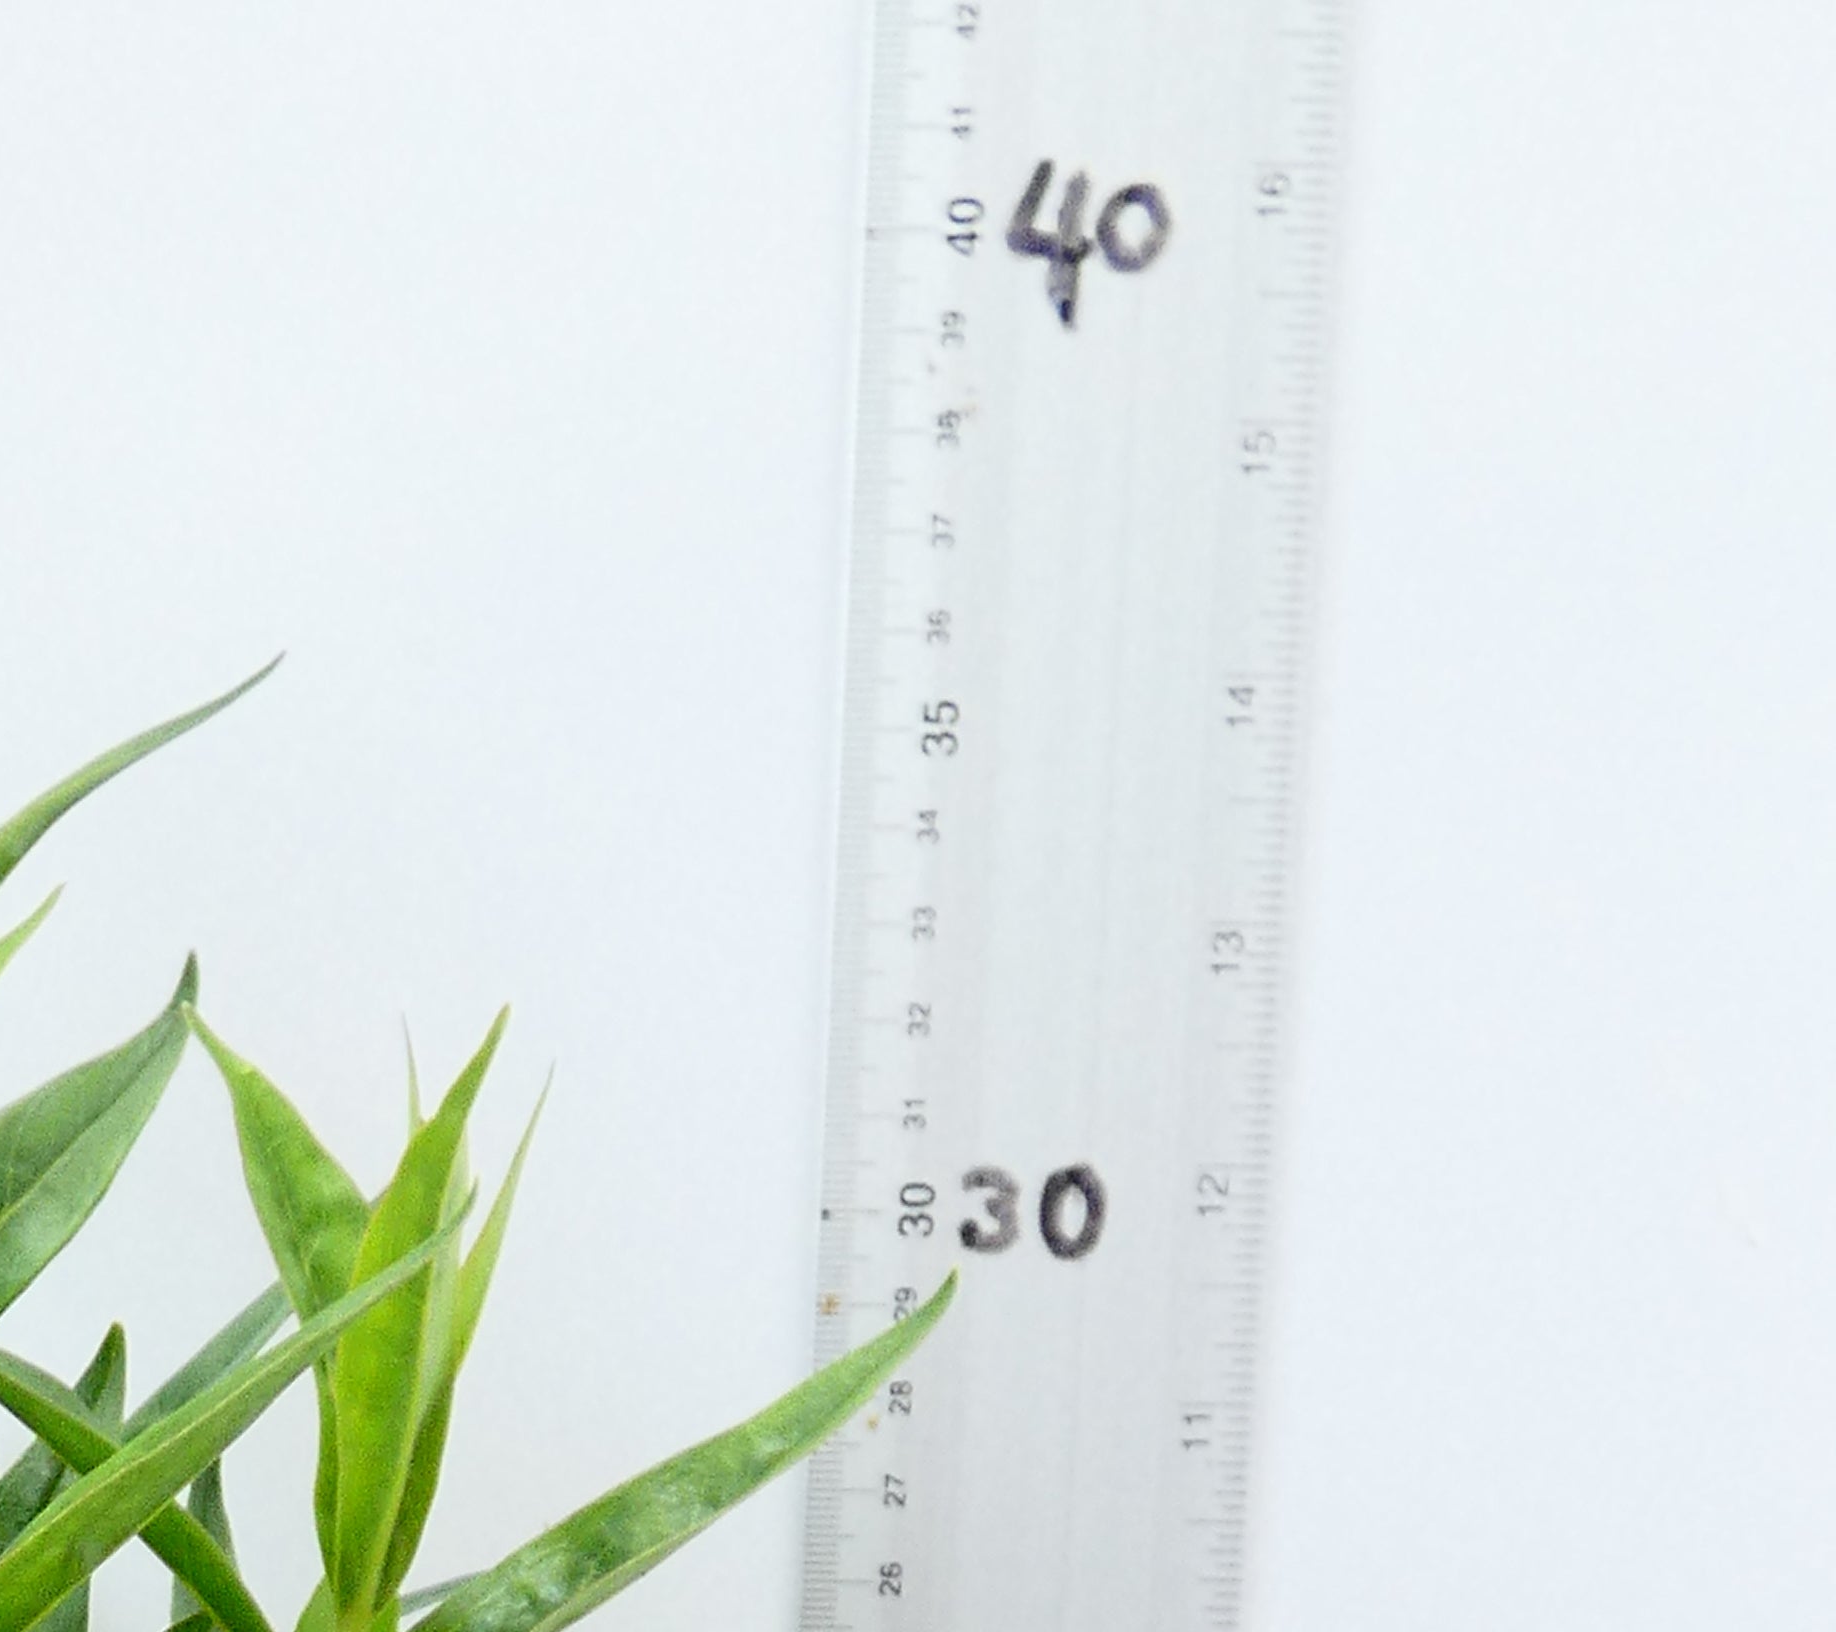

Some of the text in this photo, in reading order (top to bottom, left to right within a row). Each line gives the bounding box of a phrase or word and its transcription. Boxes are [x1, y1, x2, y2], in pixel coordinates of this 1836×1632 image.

[1256, 172, 1291, 216] 16
[947, 197, 984, 255] 40
[1006, 159, 1171, 329] 40
[942, 311, 965, 347] 39
[1240, 430, 1276, 474] 15
[932, 514, 954, 549] 37
[927, 609, 951, 644] 36
[1226, 687, 1255, 727] 14
[922, 700, 959, 757] 35
[917, 810, 939, 844] 34
[912, 907, 936, 941] 33
[1210, 931, 1245, 974] 13
[908, 1003, 931, 1037] 32
[903, 1099, 926, 1130] 31
[898, 1182, 936, 1237] 30
[959, 1163, 1107, 1260] 30
[1197, 1174, 1229, 1216] 12
[889, 1380, 912, 1416] 28
[1182, 1411, 1211, 1450] 11
[884, 1474, 907, 1507] 27
[880, 1562, 902, 1595] 26
